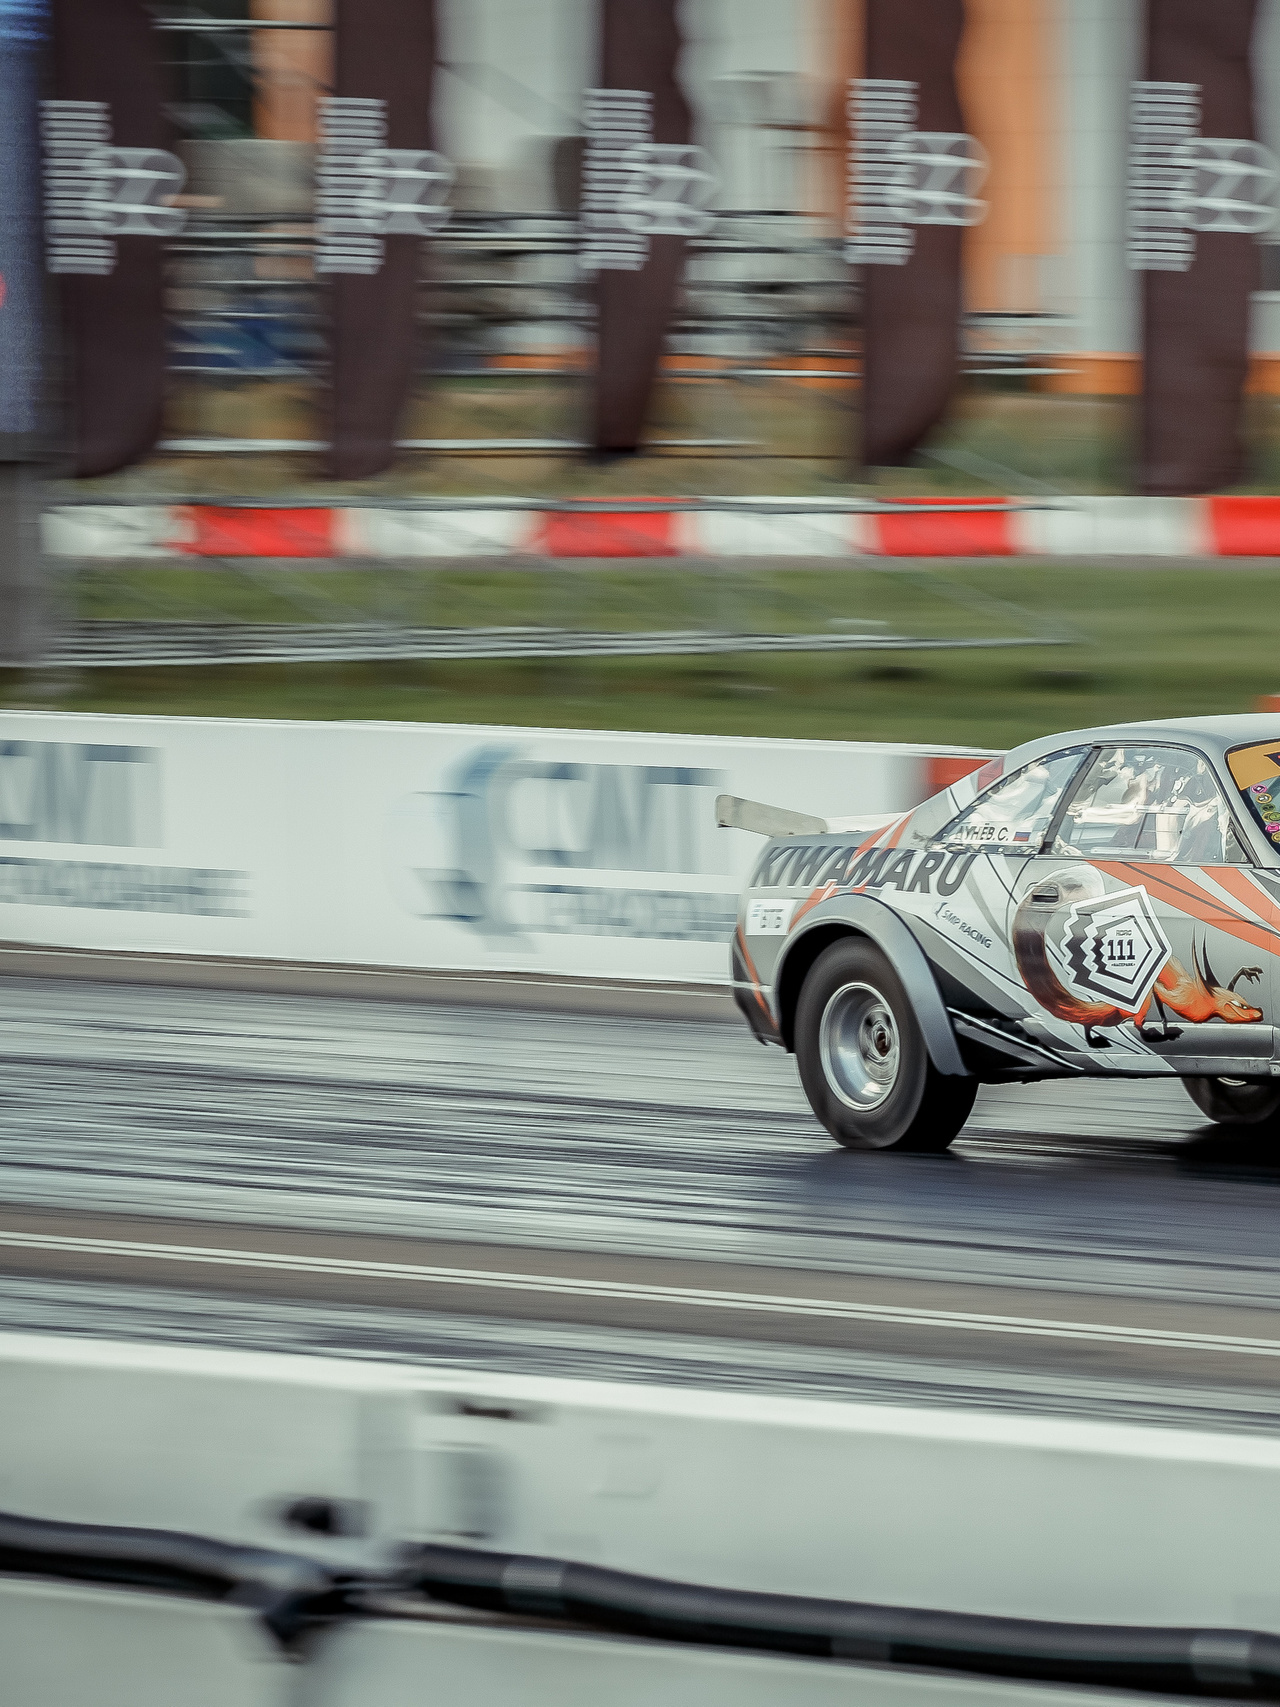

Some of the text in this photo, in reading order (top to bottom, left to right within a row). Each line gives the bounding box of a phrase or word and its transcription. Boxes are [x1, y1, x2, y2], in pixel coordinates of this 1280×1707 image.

[749, 846, 979, 897] KIWAMARU
[959, 922, 993, 949] RACING
[1107, 939, 1136, 961] 111
